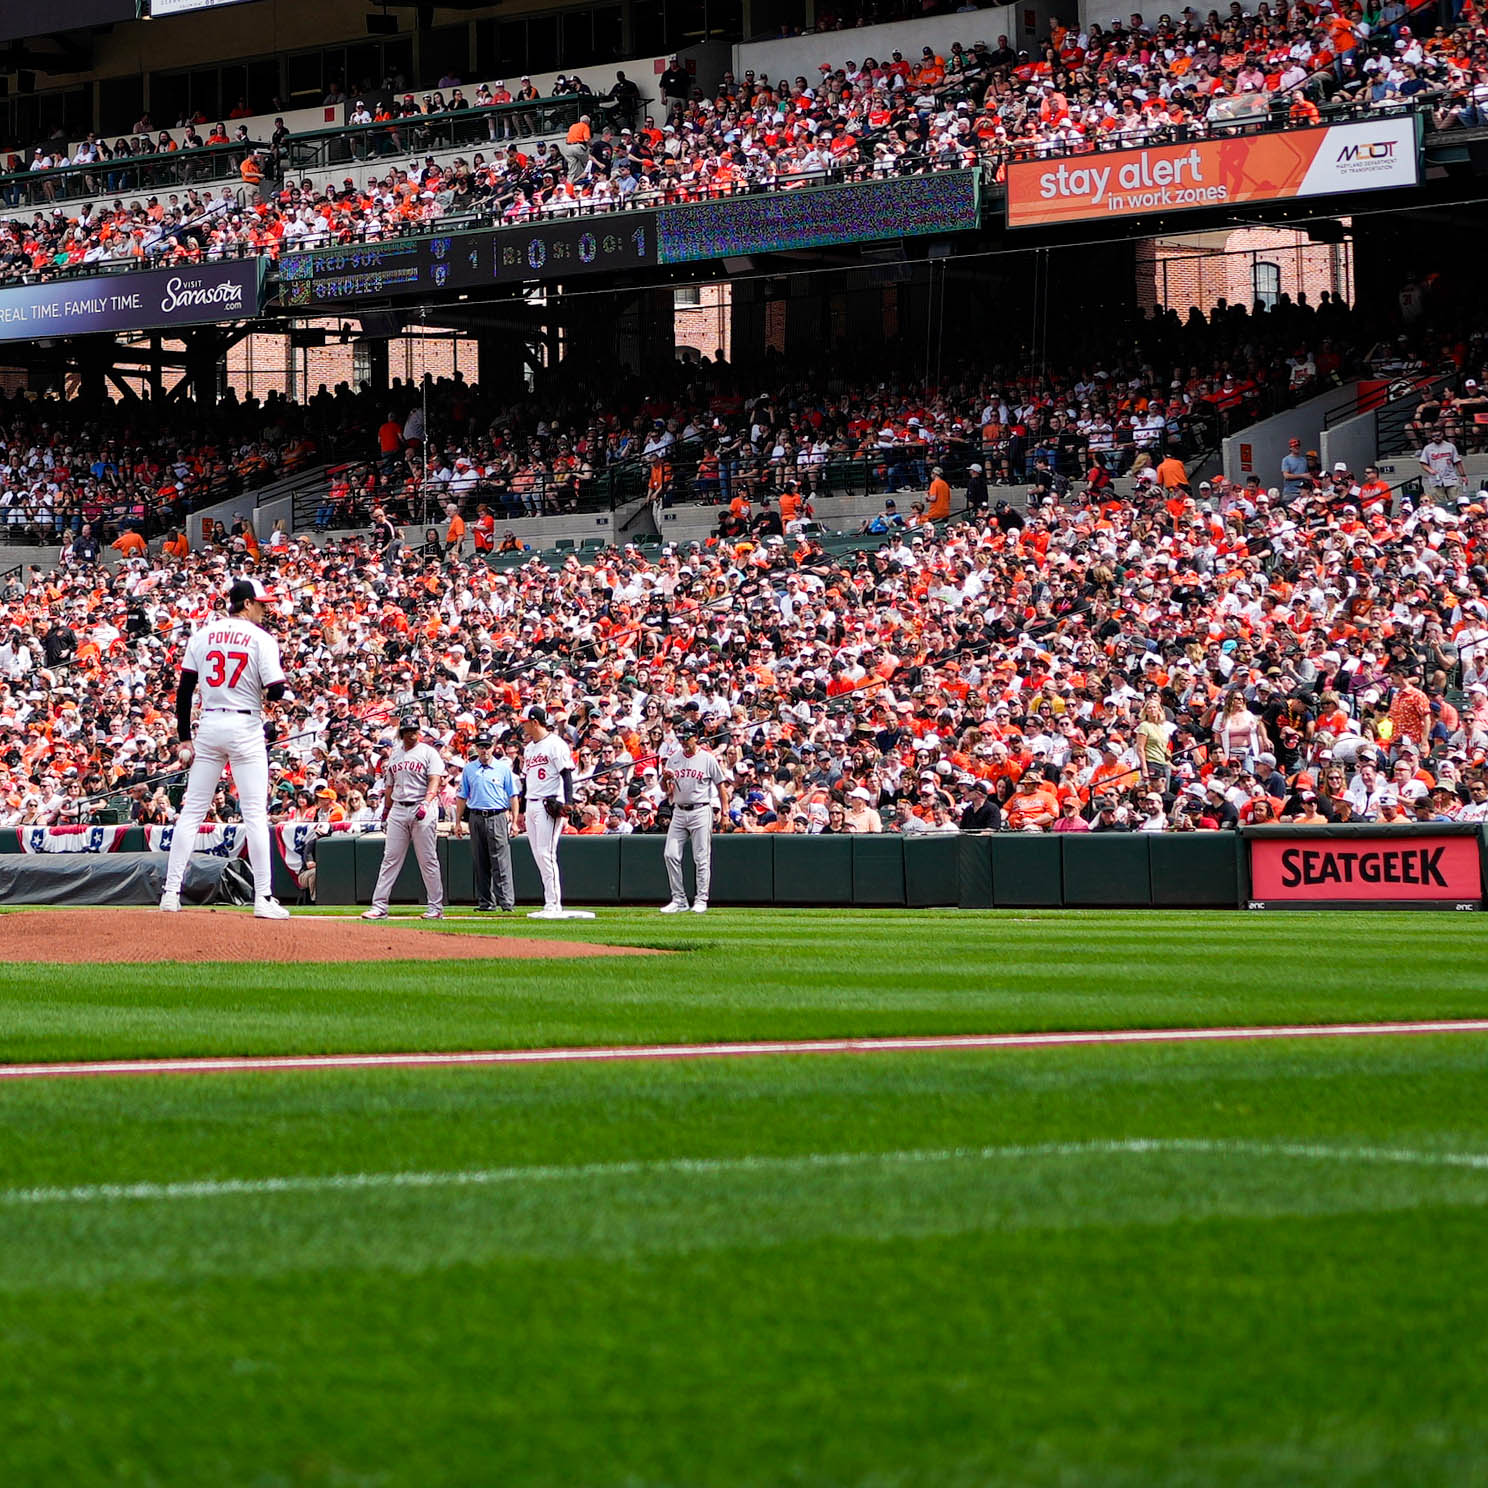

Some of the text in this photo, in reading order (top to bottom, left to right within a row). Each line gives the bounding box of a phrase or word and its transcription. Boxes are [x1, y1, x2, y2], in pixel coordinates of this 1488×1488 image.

[1039, 148, 1203, 204] stay alert
[1108, 183, 1228, 211] in work zones
[161, 277, 243, 312] Sarasota
[183, 279, 202, 289] VISIT
[31, 304, 62, 320] TIME.
[64, 297, 109, 317] FAMILY
[110, 293, 143, 311] TIME.
[223, 301, 243, 312] .com
[208, 631, 252, 648] POVICH
[205, 650, 249, 689] 37
[537, 768, 548, 780] 6
[674, 768, 705, 781] OSTON
[1281, 847, 1449, 888] SEATGEEK
